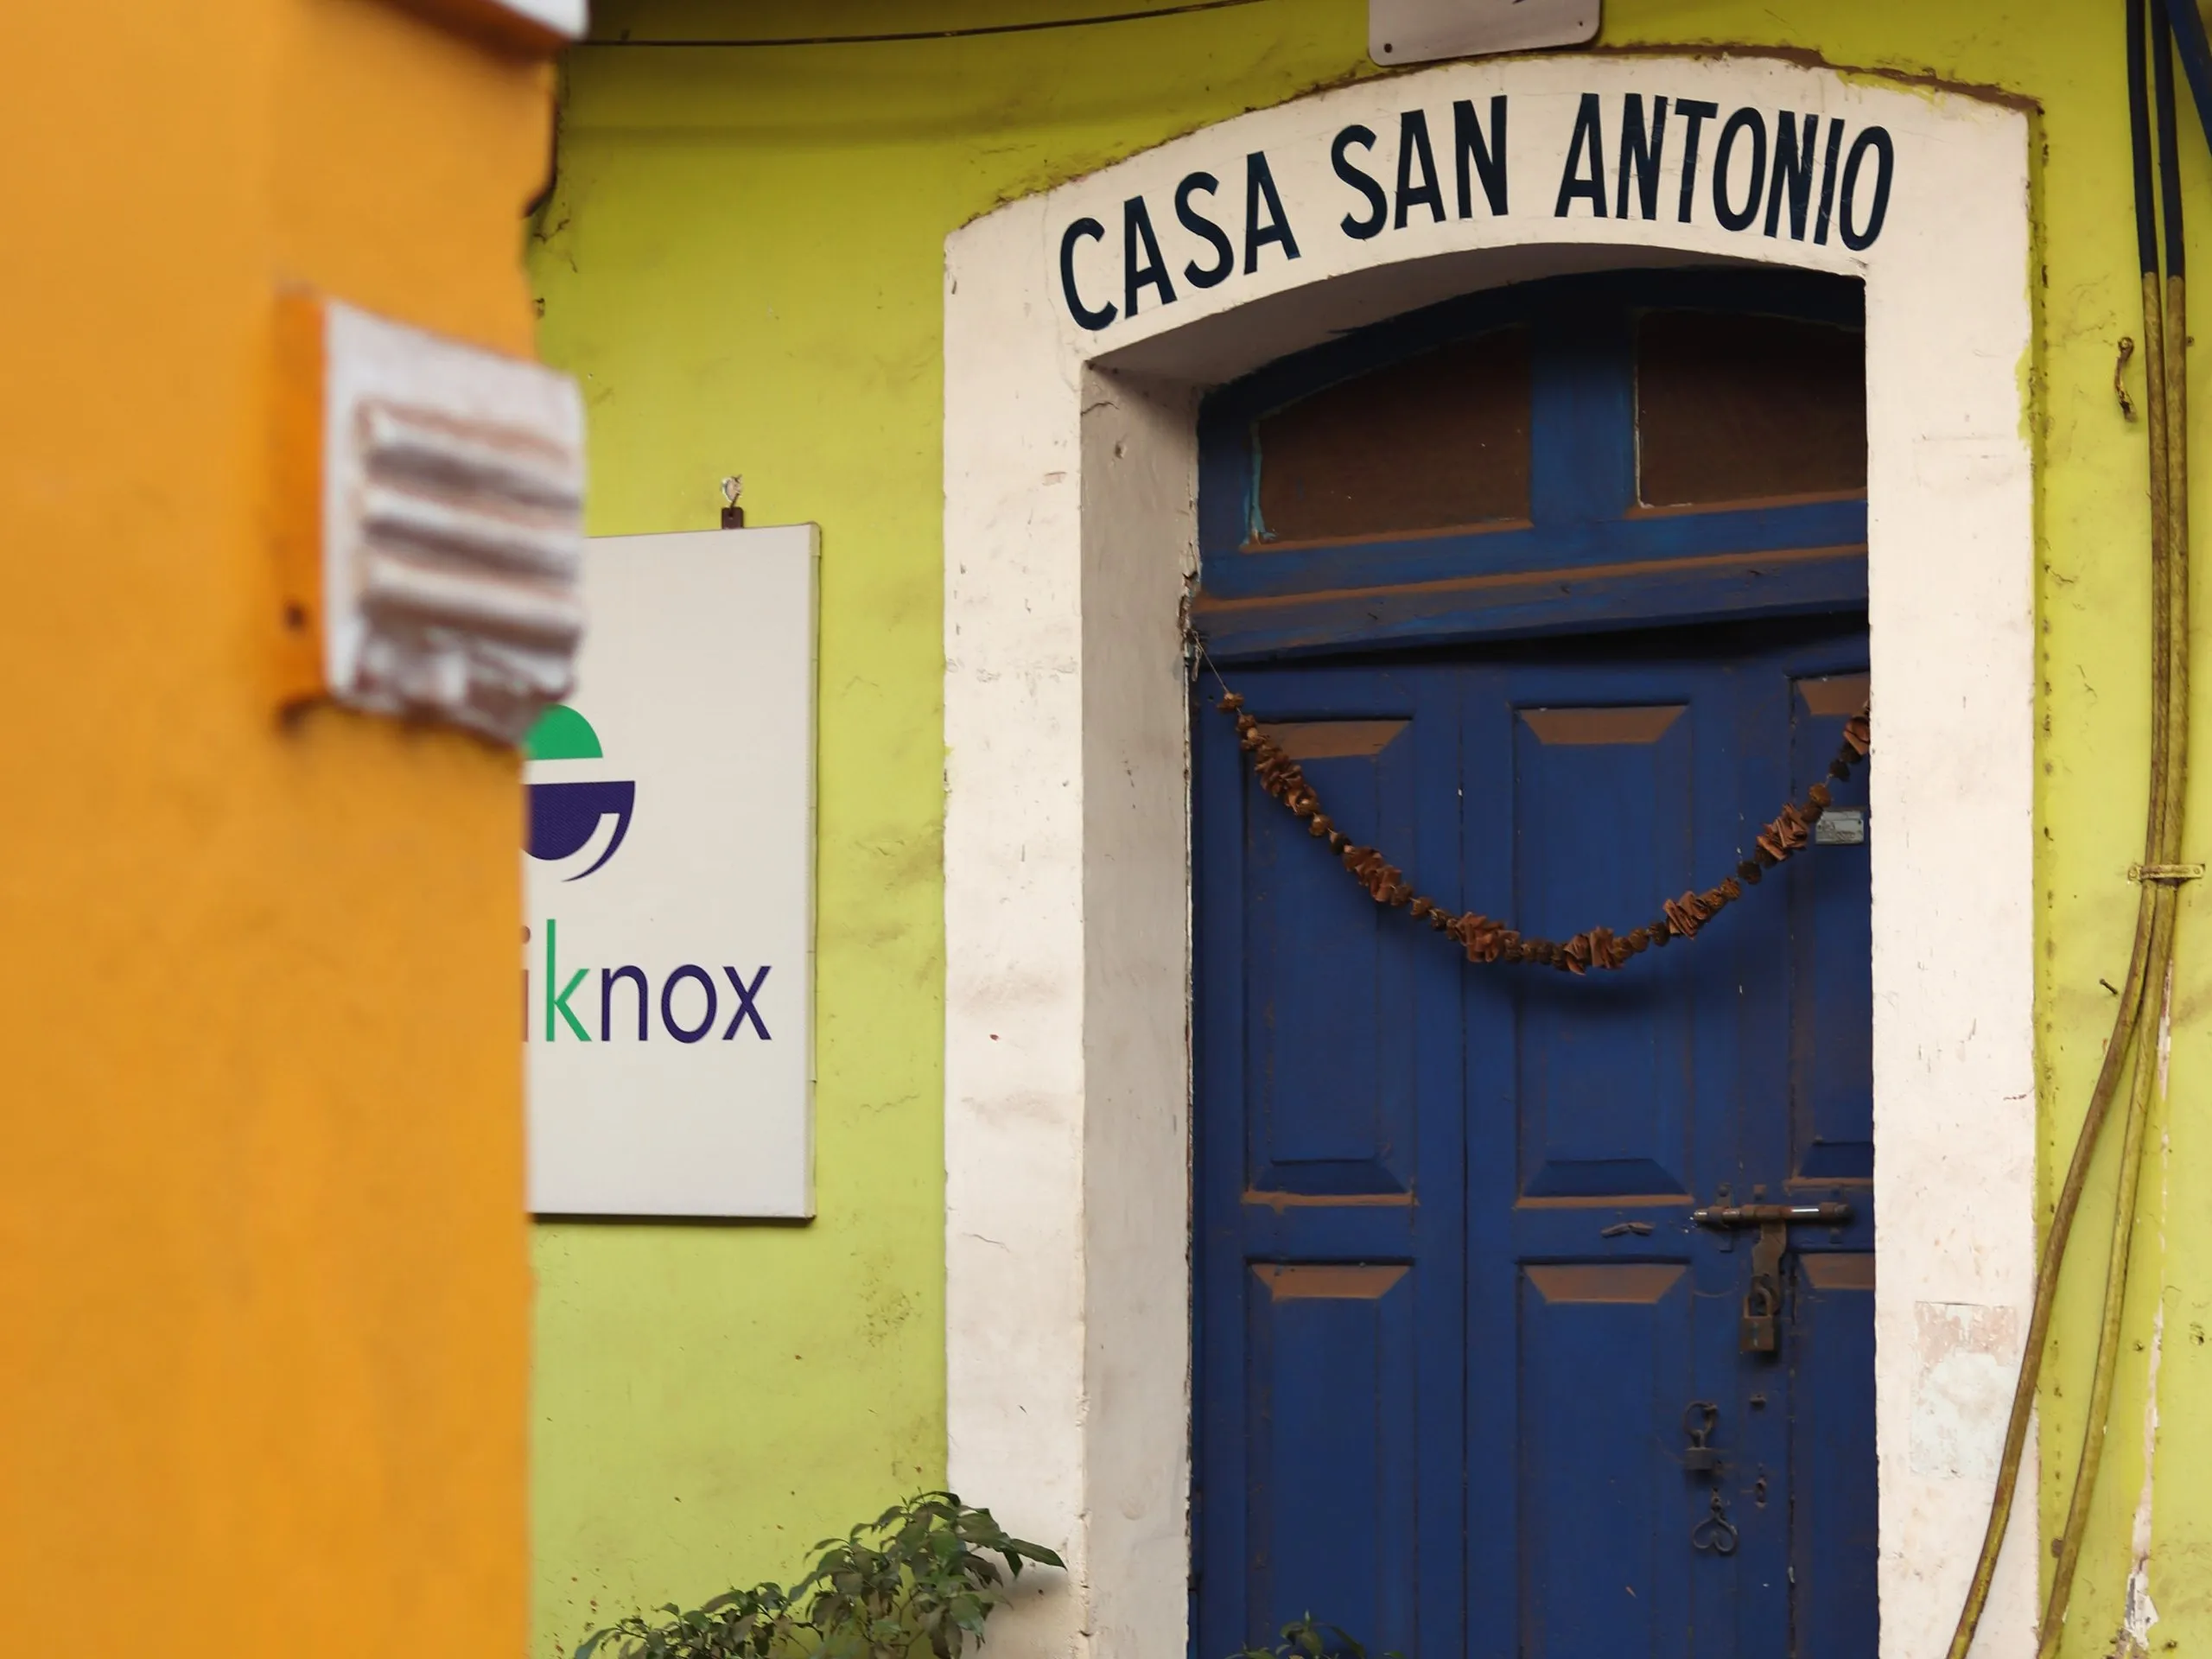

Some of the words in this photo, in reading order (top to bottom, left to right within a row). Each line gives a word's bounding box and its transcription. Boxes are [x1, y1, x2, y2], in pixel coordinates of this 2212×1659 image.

[1059, 150, 1301, 331] CASA
[1331, 94, 1509, 241] SAN
[1554, 92, 1894, 251] ANTONIO
